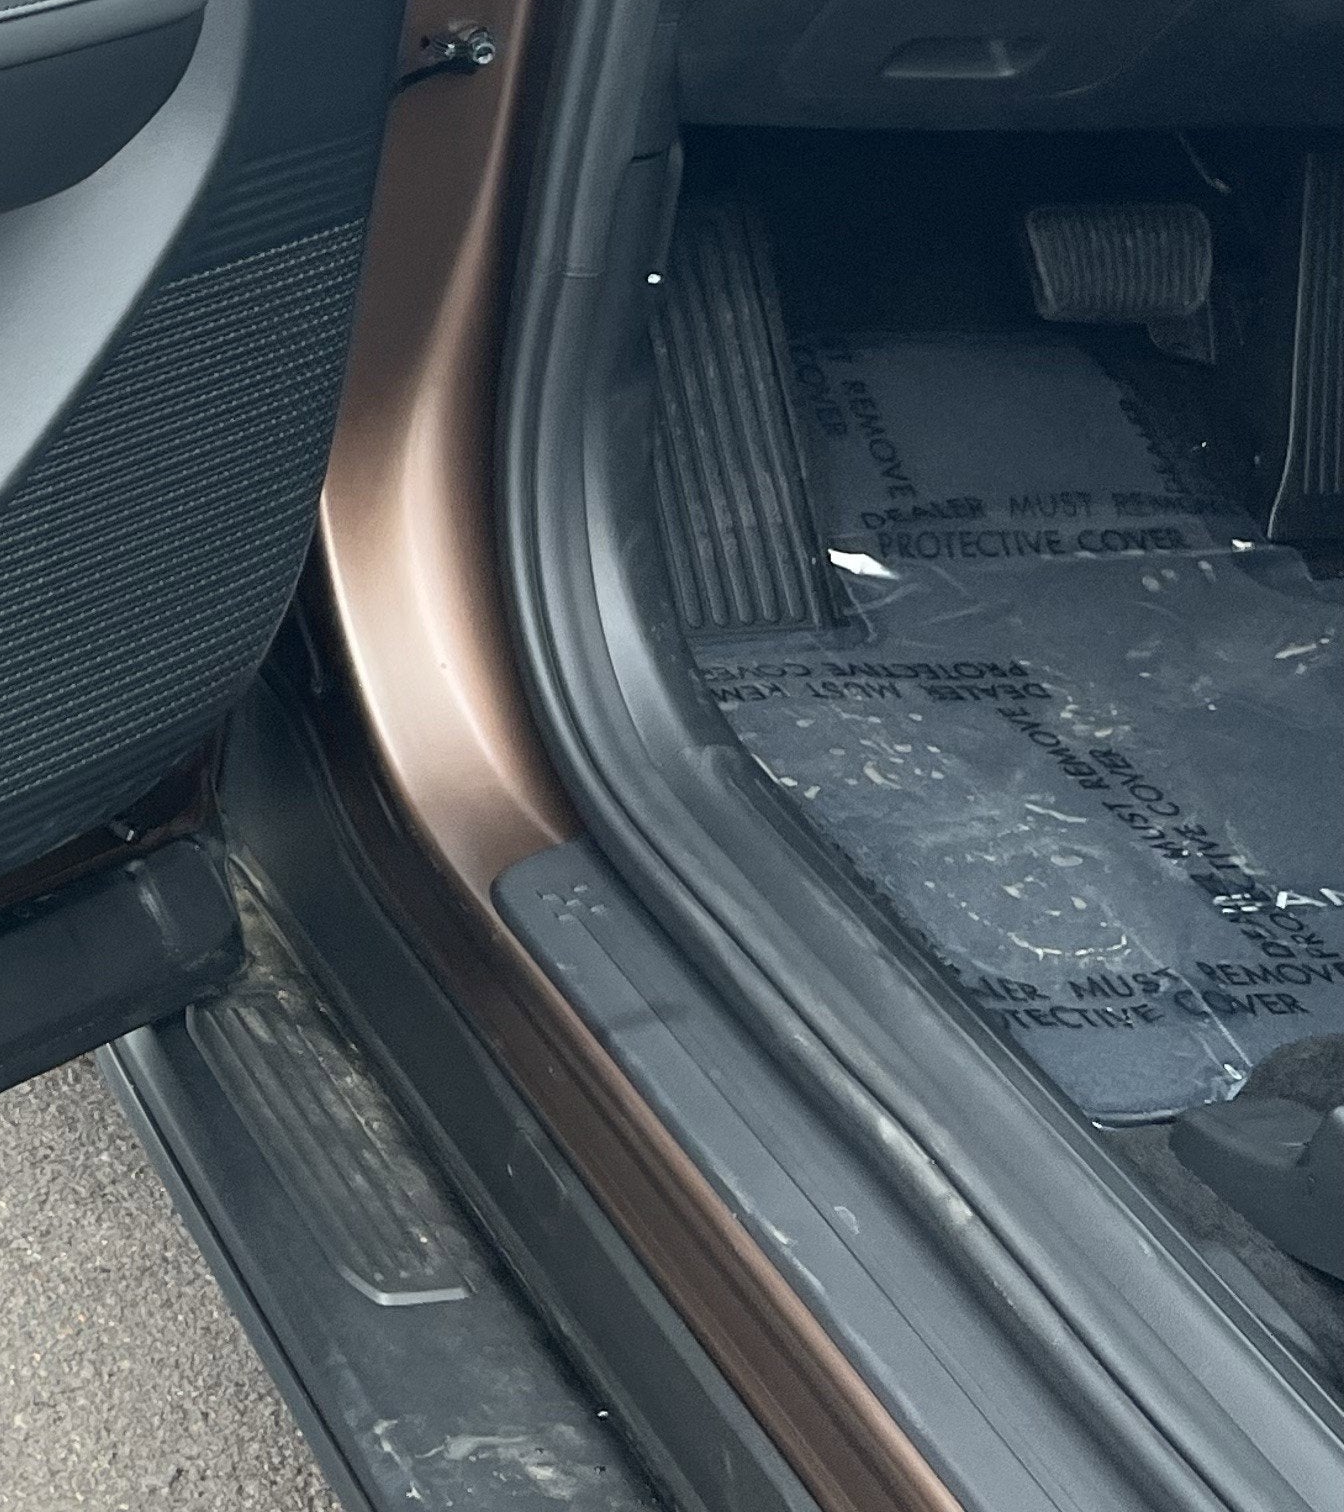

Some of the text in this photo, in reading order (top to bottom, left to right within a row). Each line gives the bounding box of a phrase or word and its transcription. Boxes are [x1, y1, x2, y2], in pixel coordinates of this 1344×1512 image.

[1009, 491, 1093, 518] MUST
[878, 527, 1191, 560] PROTECTIVE COVER
[1173, 989, 1311, 1017] COVER
